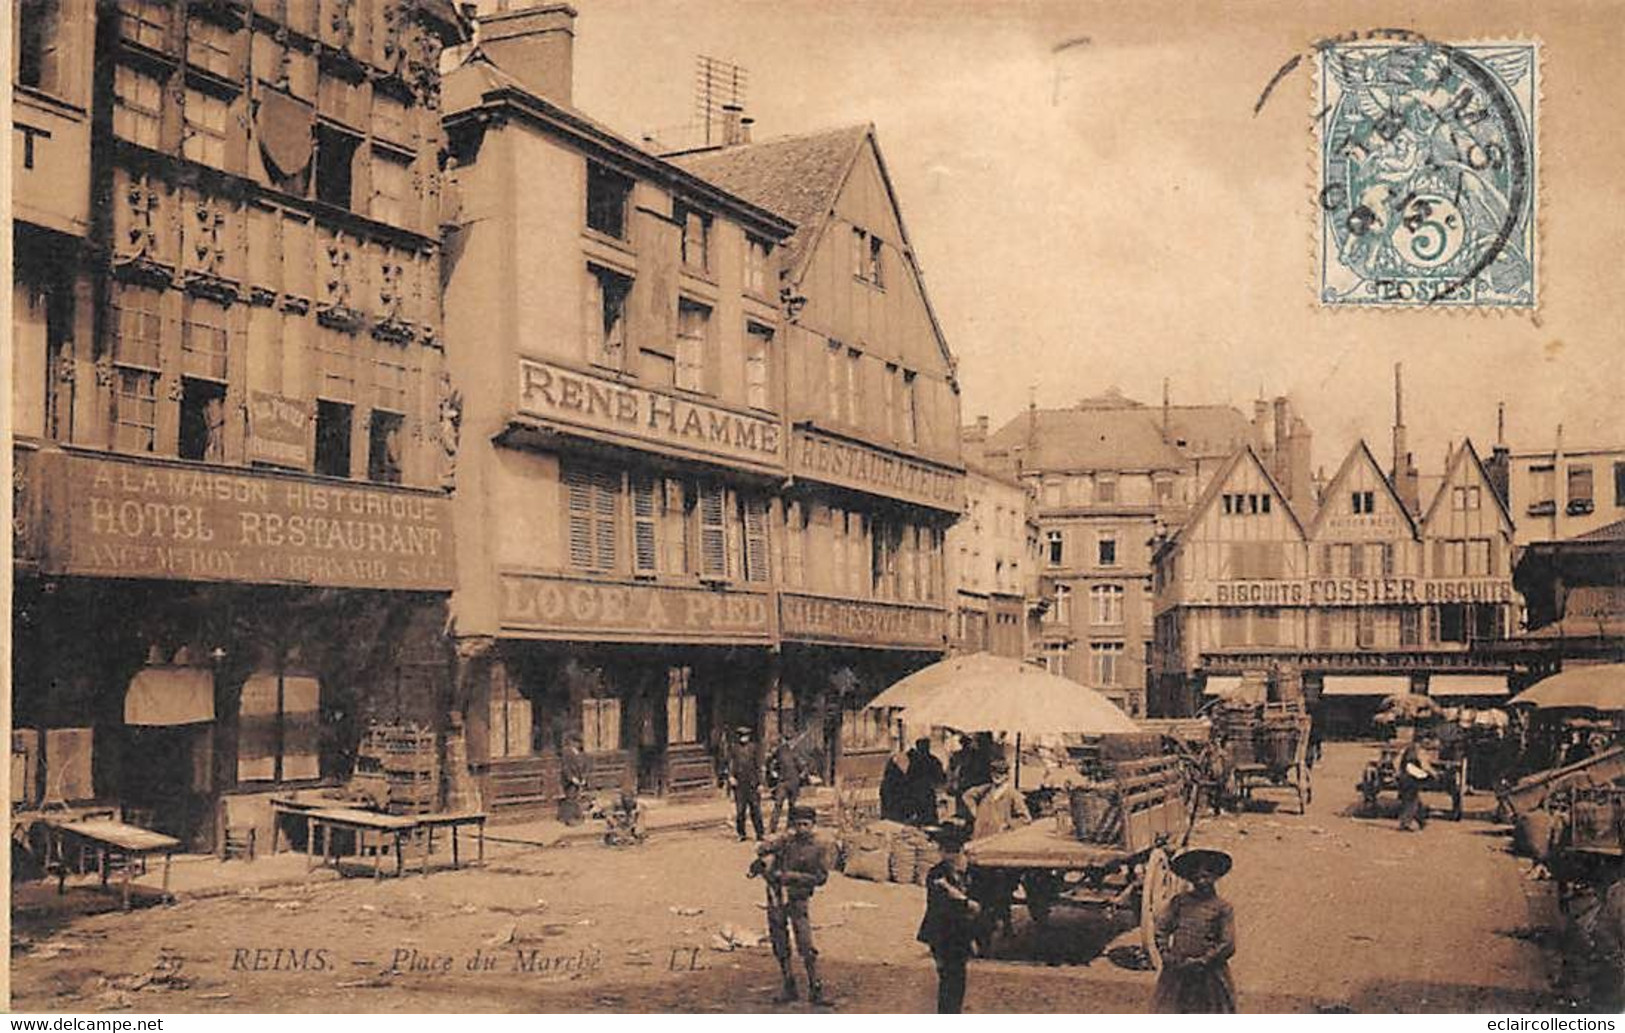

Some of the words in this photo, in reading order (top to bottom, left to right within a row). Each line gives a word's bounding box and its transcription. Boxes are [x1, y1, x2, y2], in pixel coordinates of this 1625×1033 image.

[1376, 280, 1472, 300] POSTES
[647, 394, 779, 454] HAMME
[168, 472, 268, 505] MAISON
[286, 483, 438, 521] HISTORIQUE
[88, 497, 215, 541] HOTEL
[237, 511, 443, 556] RESTAURANT
[1217, 583, 1303, 603] BISCUITS
[1308, 579, 1417, 603] FOSSIER
[1424, 581, 1512, 602] BISCUITS
